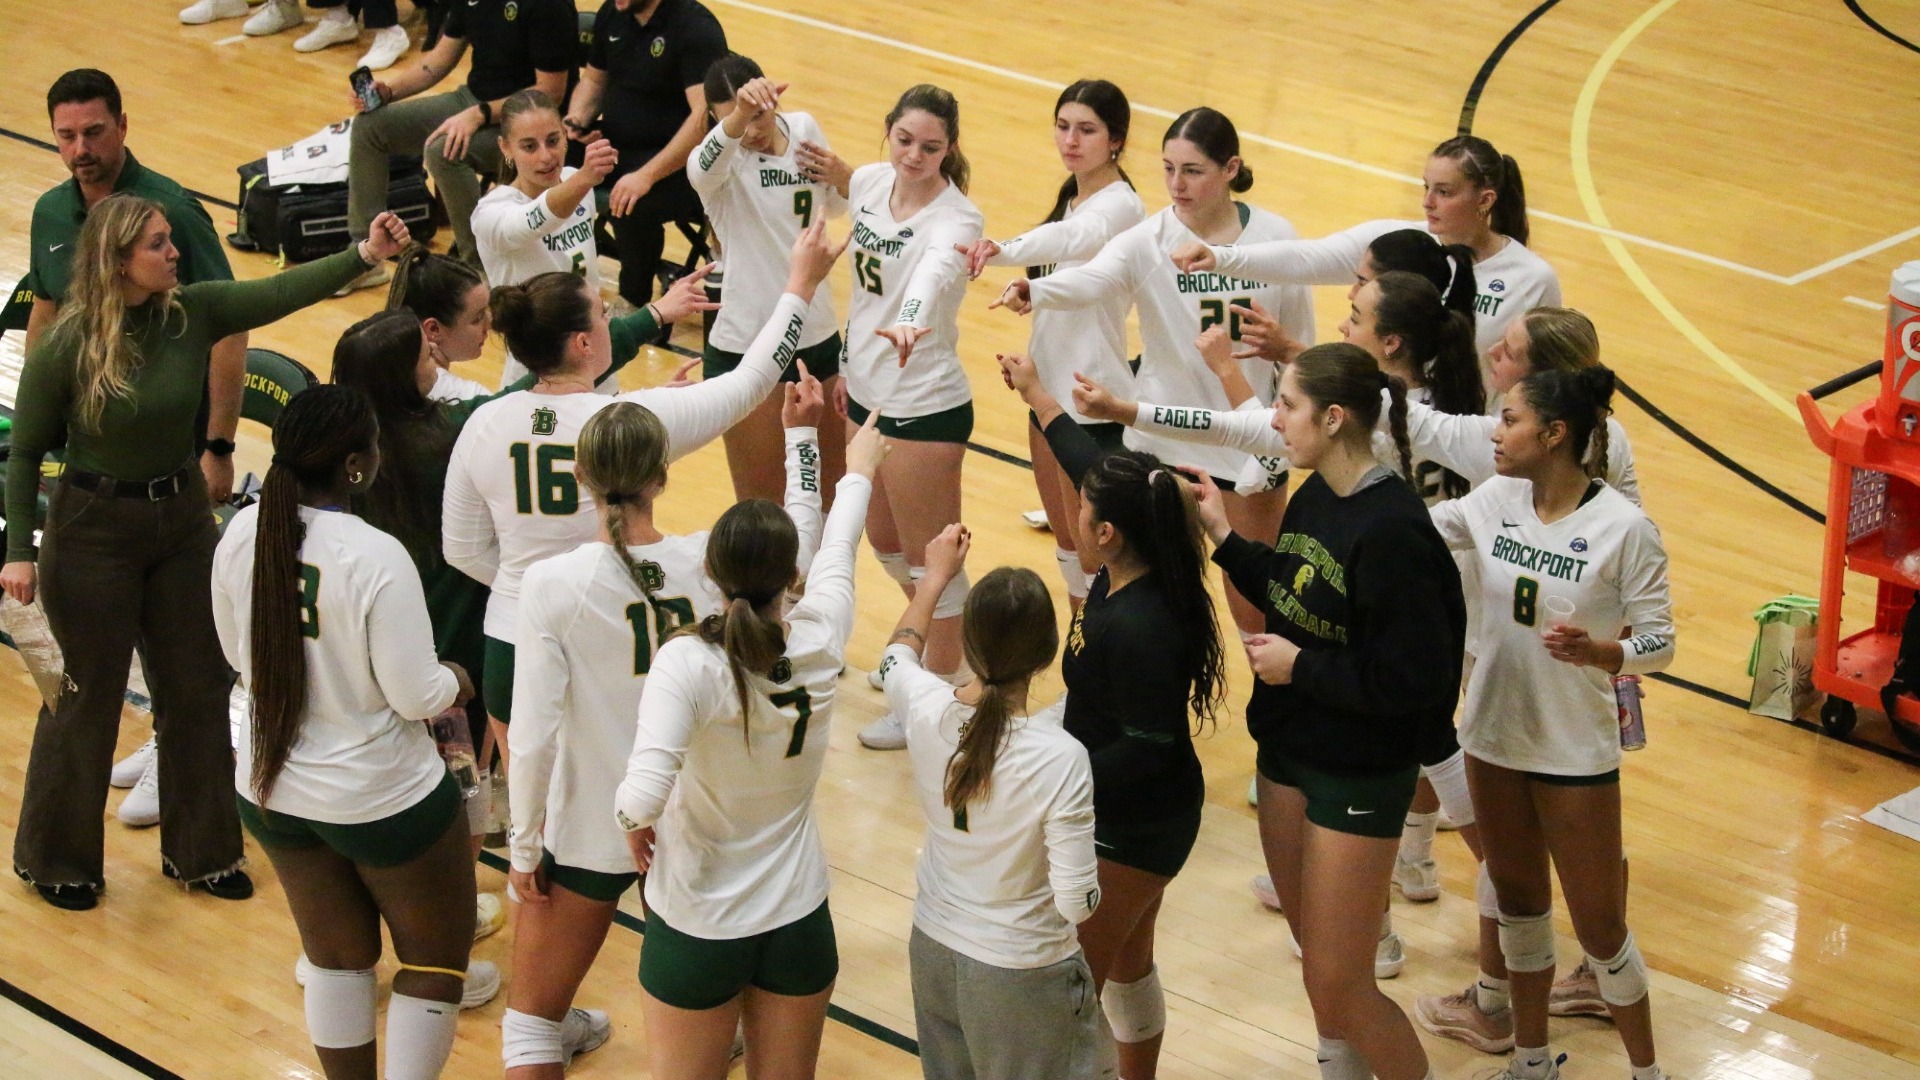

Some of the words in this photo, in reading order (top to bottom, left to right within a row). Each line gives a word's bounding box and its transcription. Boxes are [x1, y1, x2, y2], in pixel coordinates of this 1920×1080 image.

[794, 189, 813, 229] 9
[853, 220, 907, 259] ROCKPORT
[855, 250, 884, 297] 15
[1177, 272, 1268, 294] BROCKPO
[772, 313, 804, 371] GOLDEN
[244, 372, 293, 407] OCKPOR
[1154, 407, 1212, 430] EAGLES
[509, 441, 580, 516] 16
[1491, 534, 1589, 583] BROCKPORT
[1513, 574, 1540, 628] 8
[1629, 633, 1669, 655] EAGLE
[769, 685, 813, 759] 7
